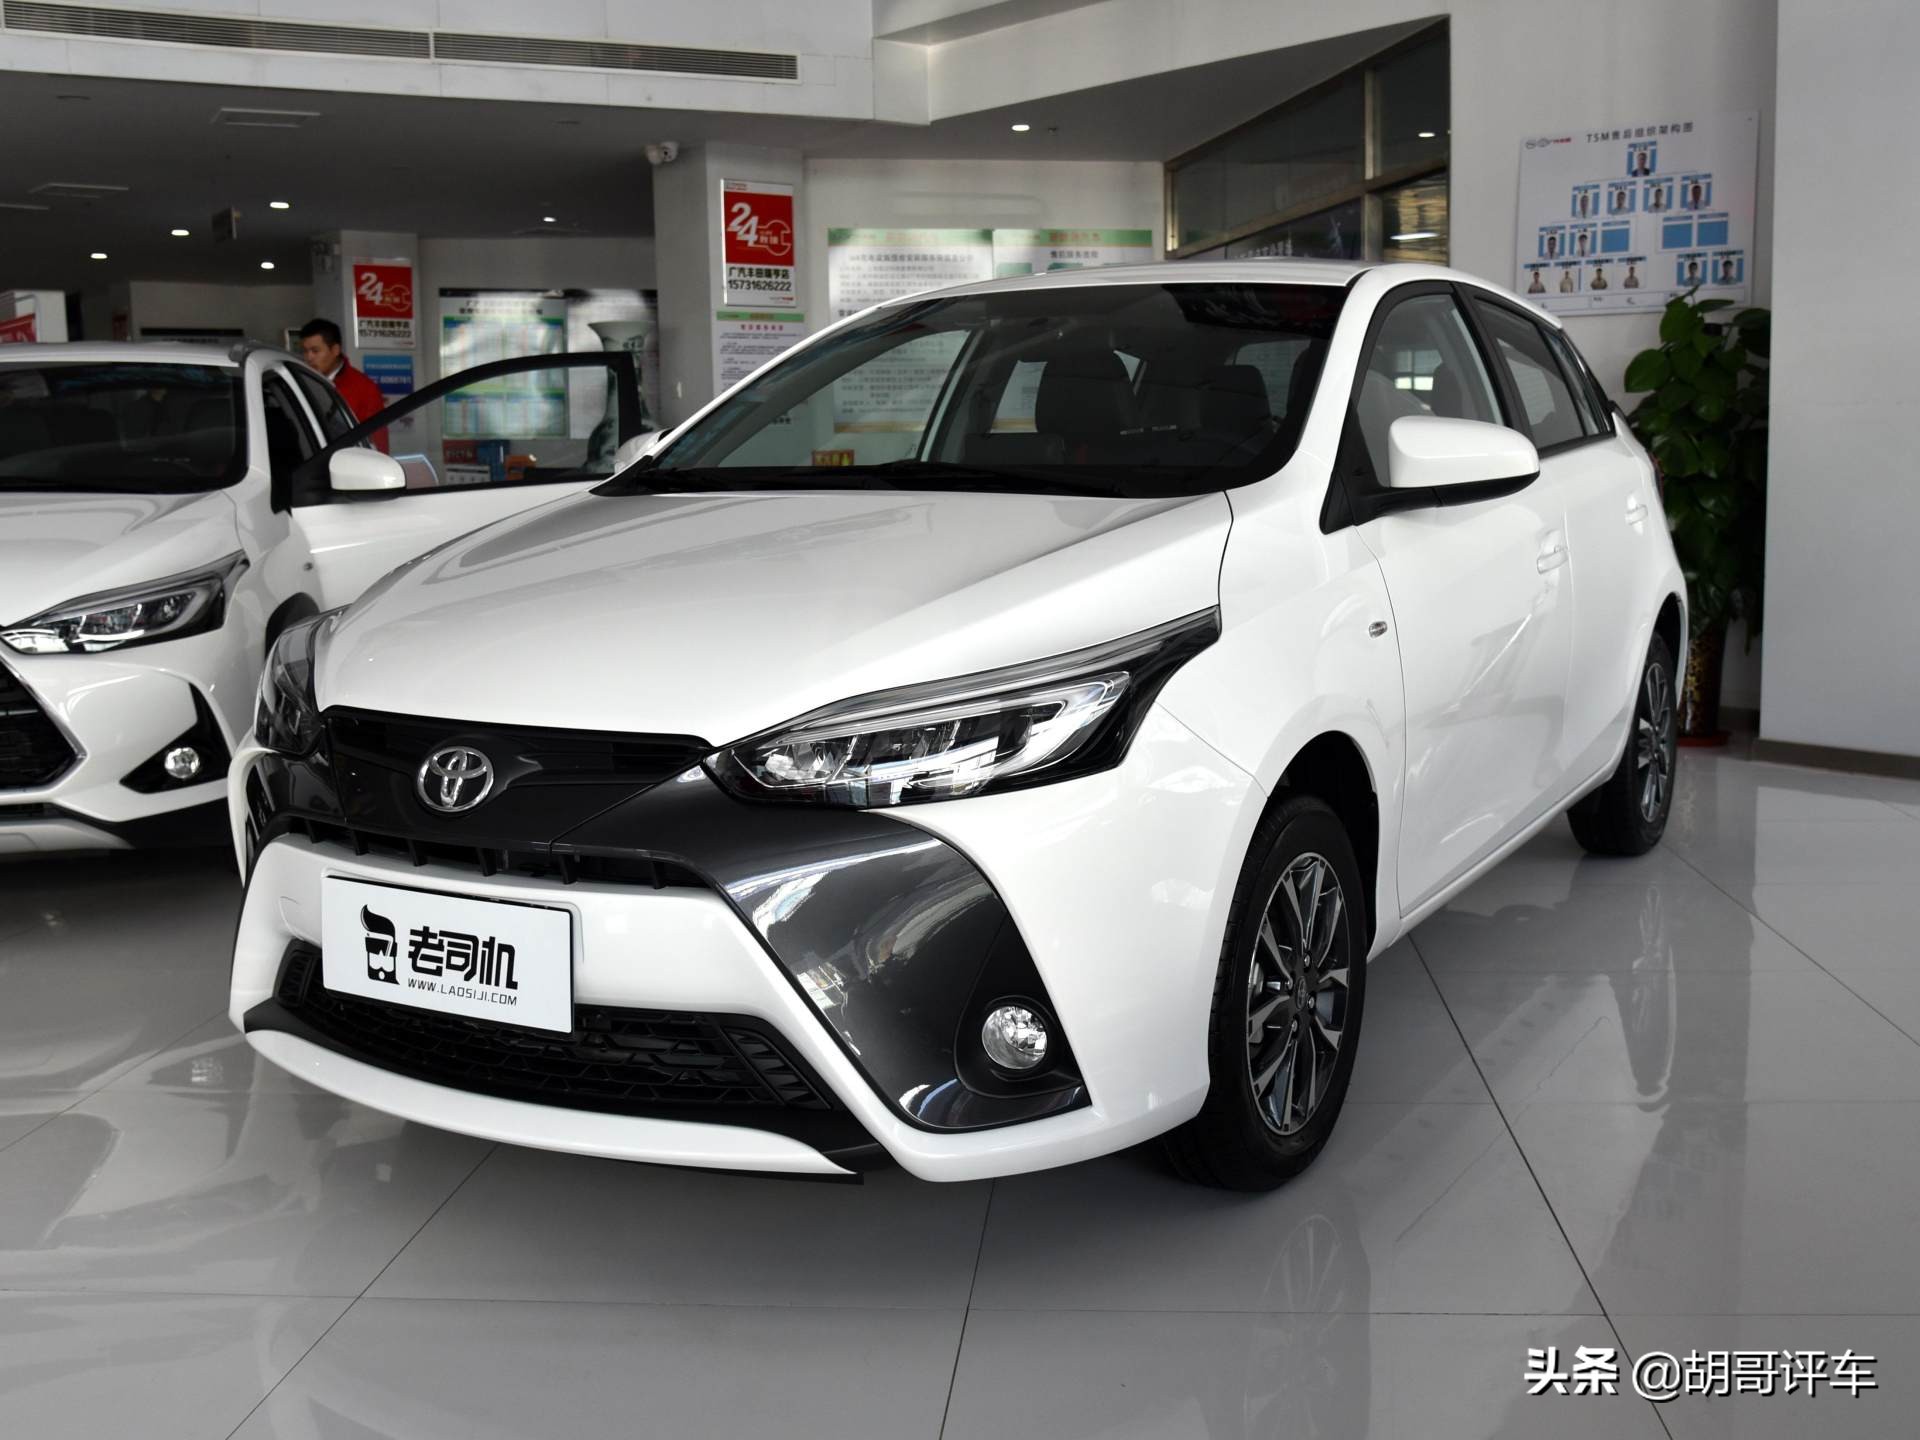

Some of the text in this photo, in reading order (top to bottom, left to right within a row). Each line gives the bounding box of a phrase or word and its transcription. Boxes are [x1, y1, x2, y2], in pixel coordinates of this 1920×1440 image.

[727, 202, 759, 247] 24
[358, 272, 384, 305] 24
[728, 280, 792, 291] 15731626222
[407, 925, 518, 990] 老司机
[407, 977, 517, 1006] WWW.LAOSIJI.COM
